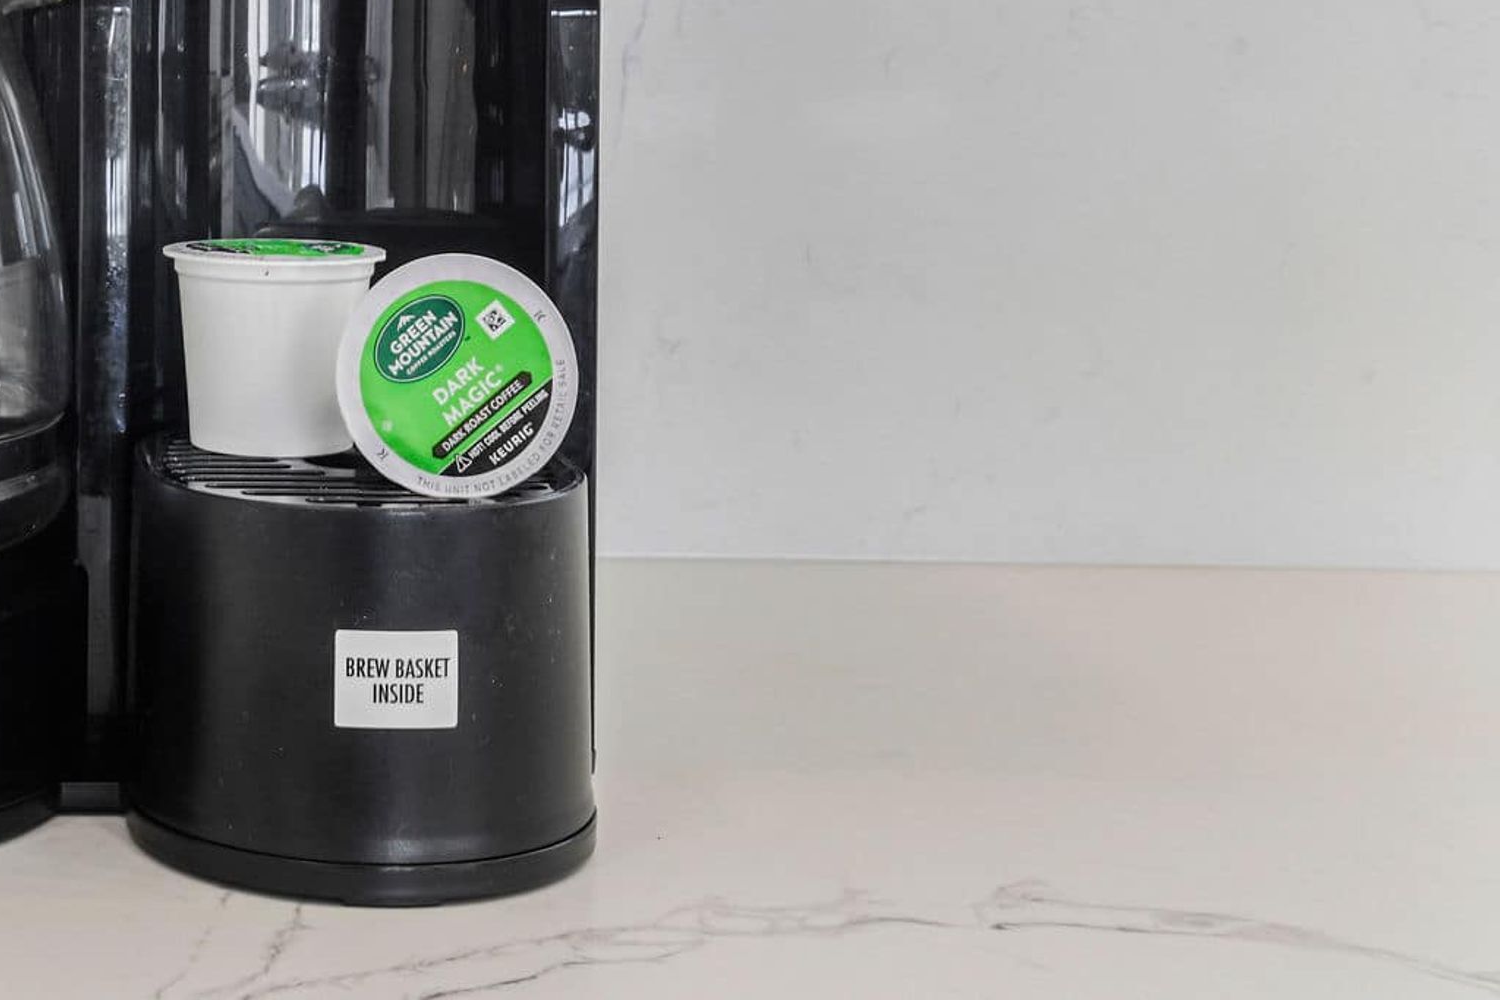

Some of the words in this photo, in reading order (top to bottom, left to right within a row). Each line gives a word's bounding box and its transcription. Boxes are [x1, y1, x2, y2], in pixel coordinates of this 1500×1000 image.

[388, 311, 458, 376] MOUNTAIN
[390, 310, 437, 354] GREEN
[432, 356, 485, 405] DARK
[442, 427, 467, 452] DARK
[464, 404, 493, 434] ROAST
[490, 379, 522, 410] COFFEE
[472, 478, 496, 492] NOT
[346, 657, 390, 678] BREW
[395, 657, 451, 679] BASKET
[373, 683, 424, 704] INSIDE
